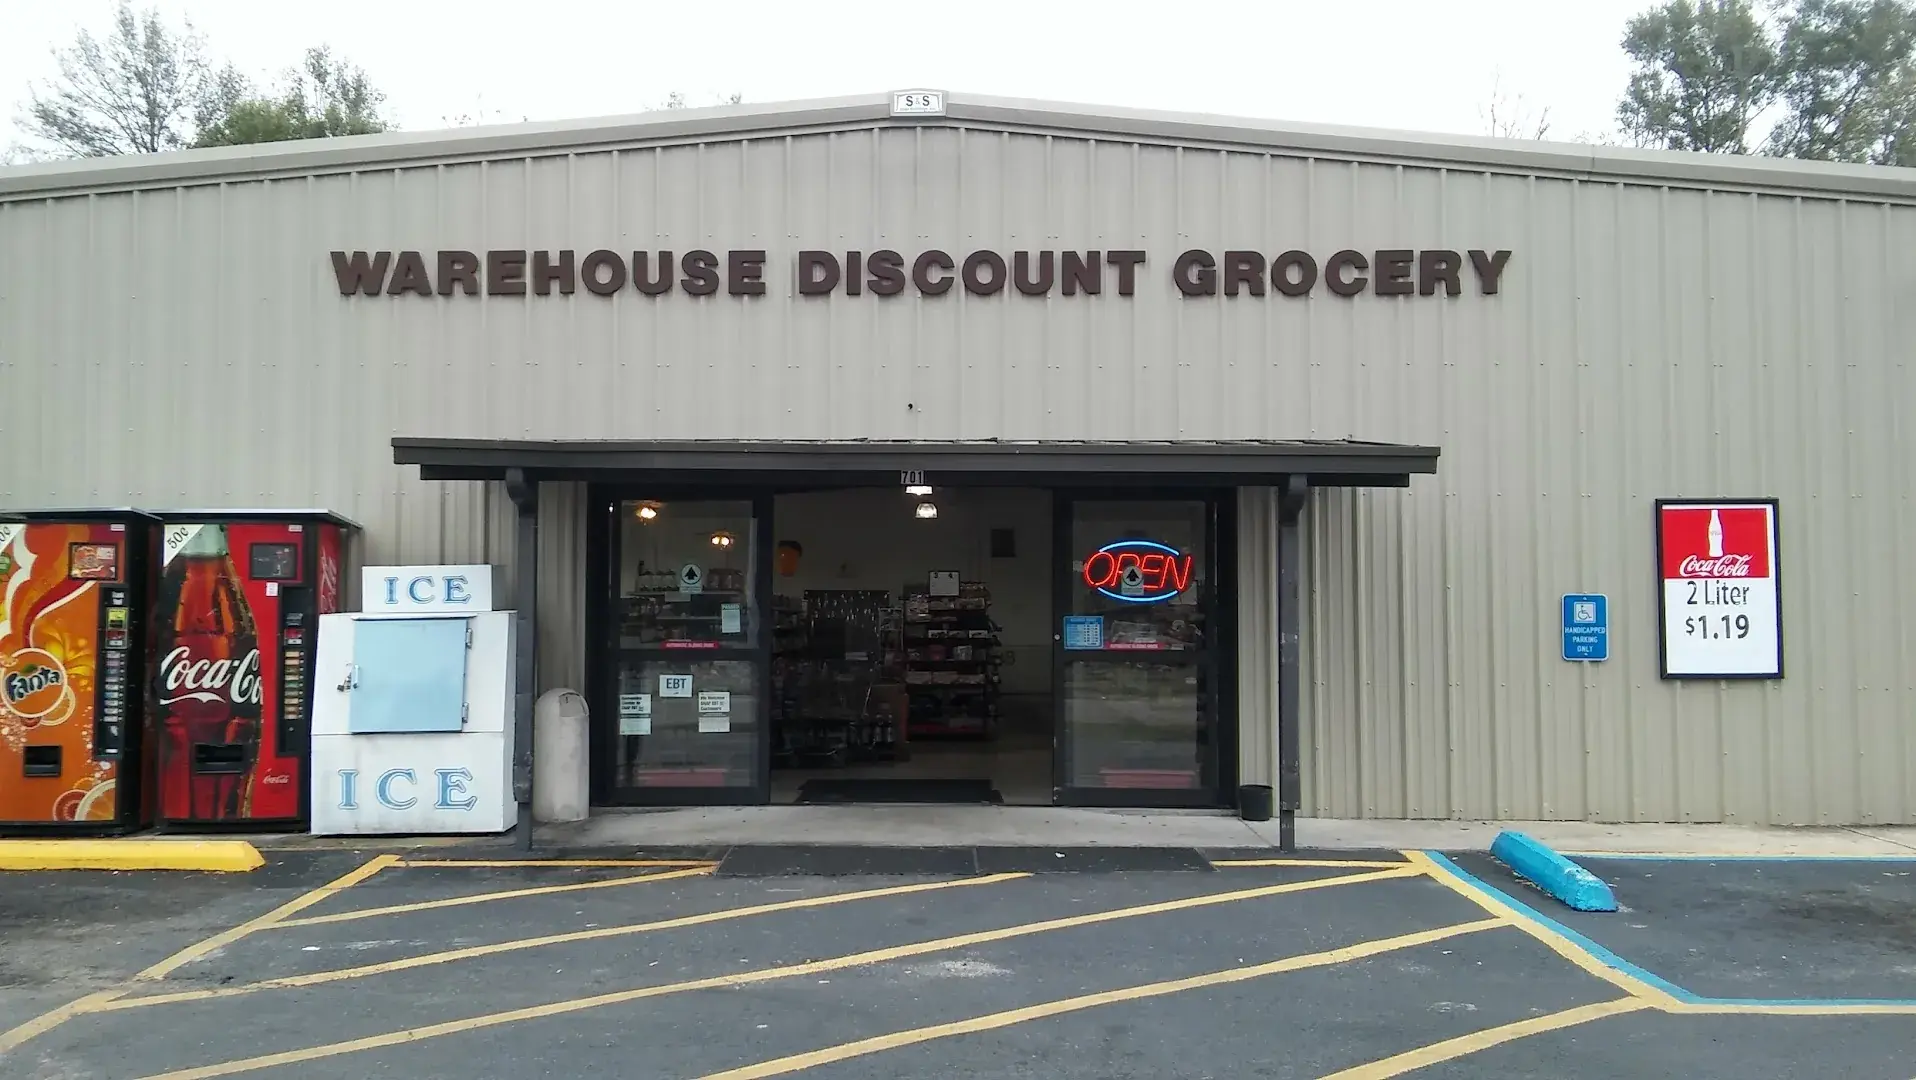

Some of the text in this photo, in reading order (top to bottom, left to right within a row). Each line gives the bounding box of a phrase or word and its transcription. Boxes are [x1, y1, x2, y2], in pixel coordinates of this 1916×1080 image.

[905, 95, 914, 107] S
[922, 95, 930, 107] S
[330, 249, 1513, 296] WAREHOUSE DISCOUNT GROCERY
[902, 470, 922, 484] 701
[1084, 551, 1192, 590] OPEN
[1680, 554, 1754, 577] Coca-Cola
[384, 575, 472, 604] ICE
[1687, 579, 1750, 605] 2 Liter
[1564, 626, 1606, 634] HANDICAPPED
[1685, 614, 1750, 639] $1.19
[1576, 645, 1594, 653] ONLY
[5, 665, 62, 703] Fanta
[666, 678, 687, 689] EBT
[337, 767, 478, 811] ICE
